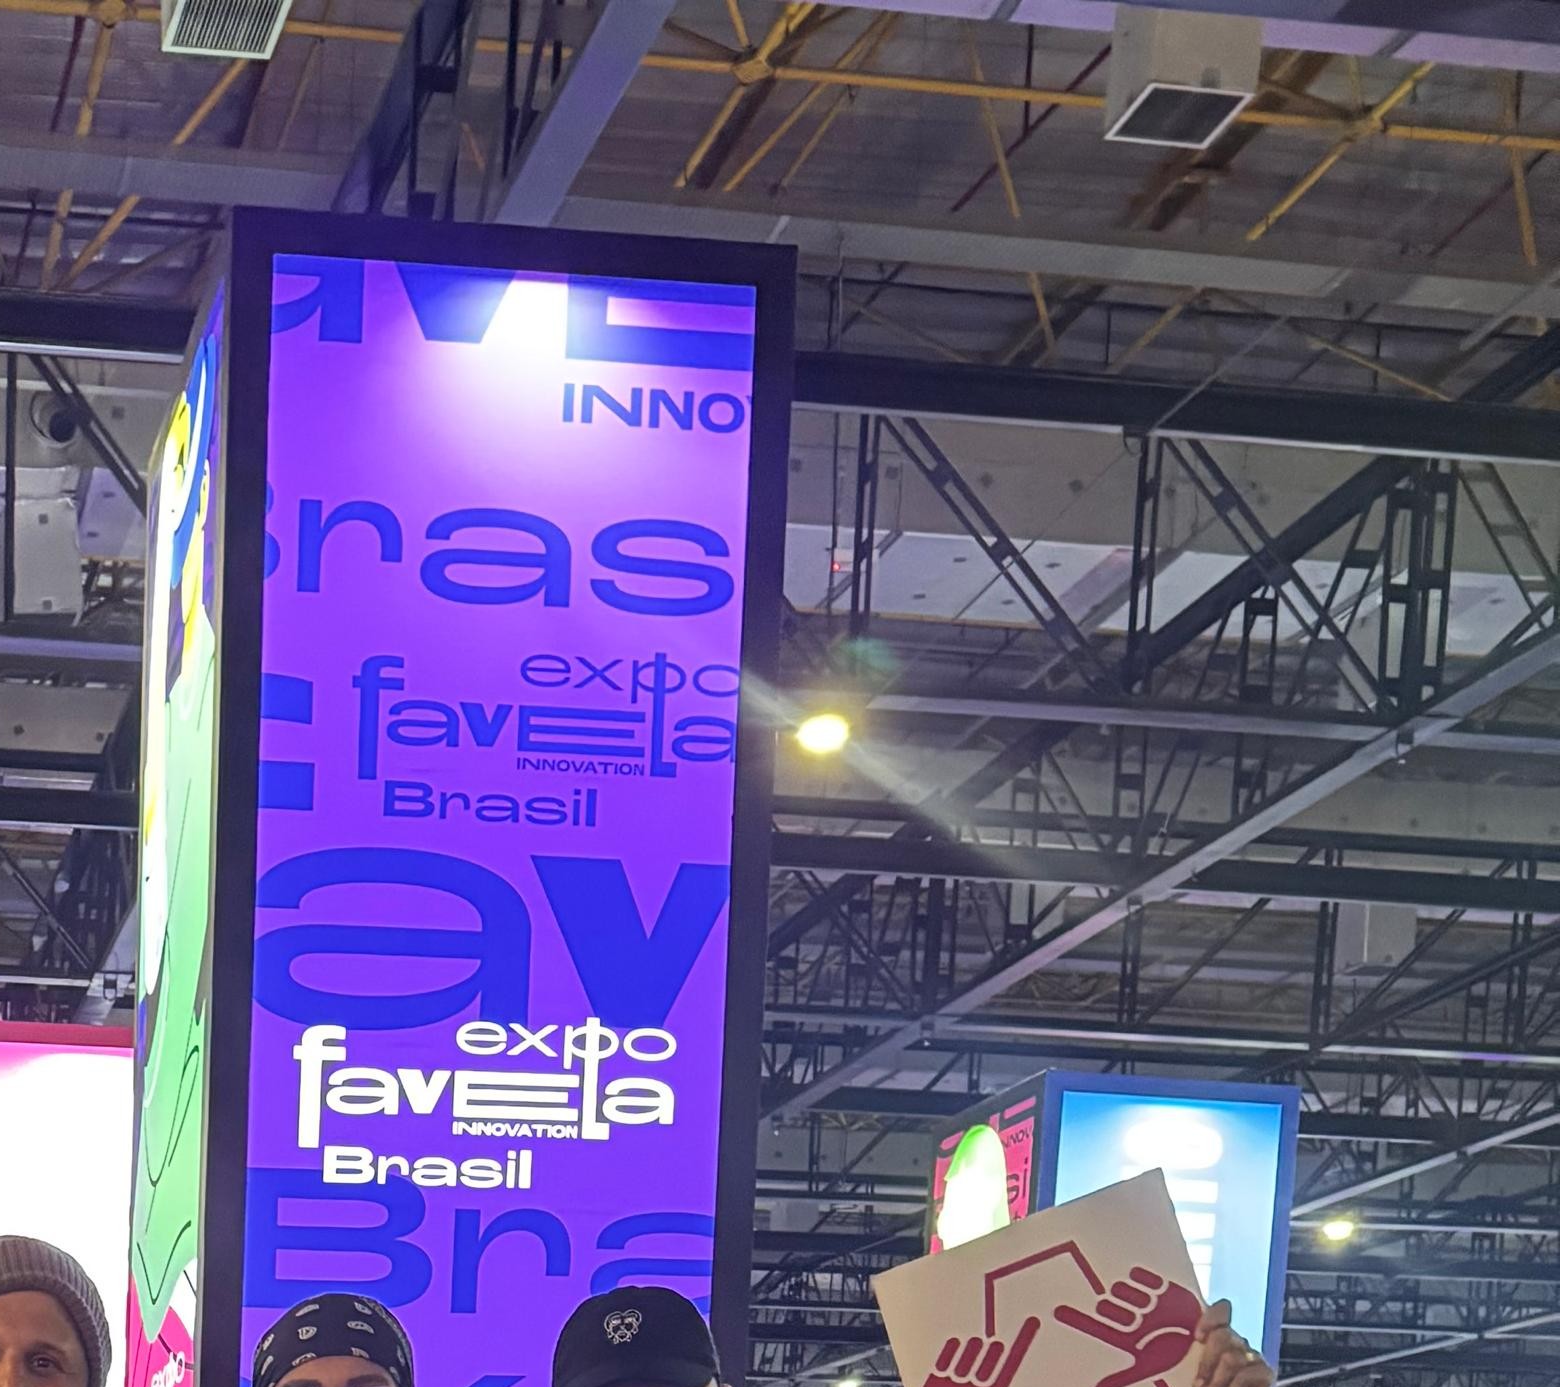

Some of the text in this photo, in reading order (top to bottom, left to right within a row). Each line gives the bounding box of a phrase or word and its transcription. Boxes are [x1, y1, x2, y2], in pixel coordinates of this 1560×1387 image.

[515, 756, 646, 777] INNOVATION
[382, 780, 598, 828] Brasil
[454, 1018, 678, 1071] expo
[452, 1120, 579, 1140] INNOVATION
[322, 1145, 533, 1190] Brasil
